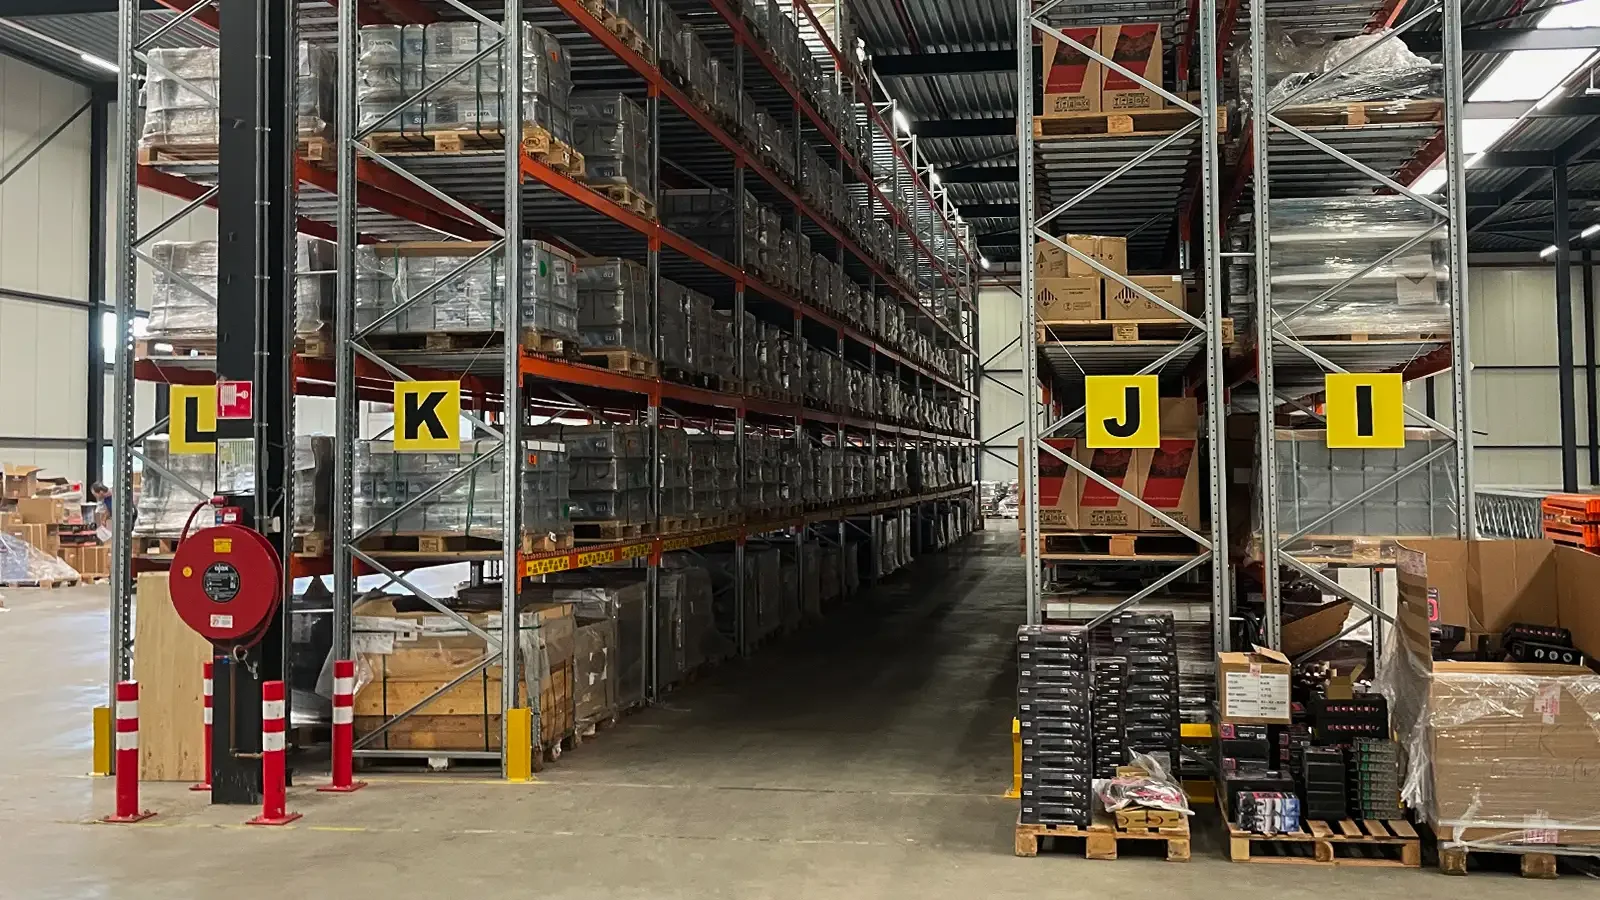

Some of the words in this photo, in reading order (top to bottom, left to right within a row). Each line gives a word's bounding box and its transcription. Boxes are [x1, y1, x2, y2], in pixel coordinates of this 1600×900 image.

[185, 397, 216, 442] L
[404, 392, 450, 439] K
[1102, 386, 1140, 437] J
[1355, 385, 1373, 437] I
